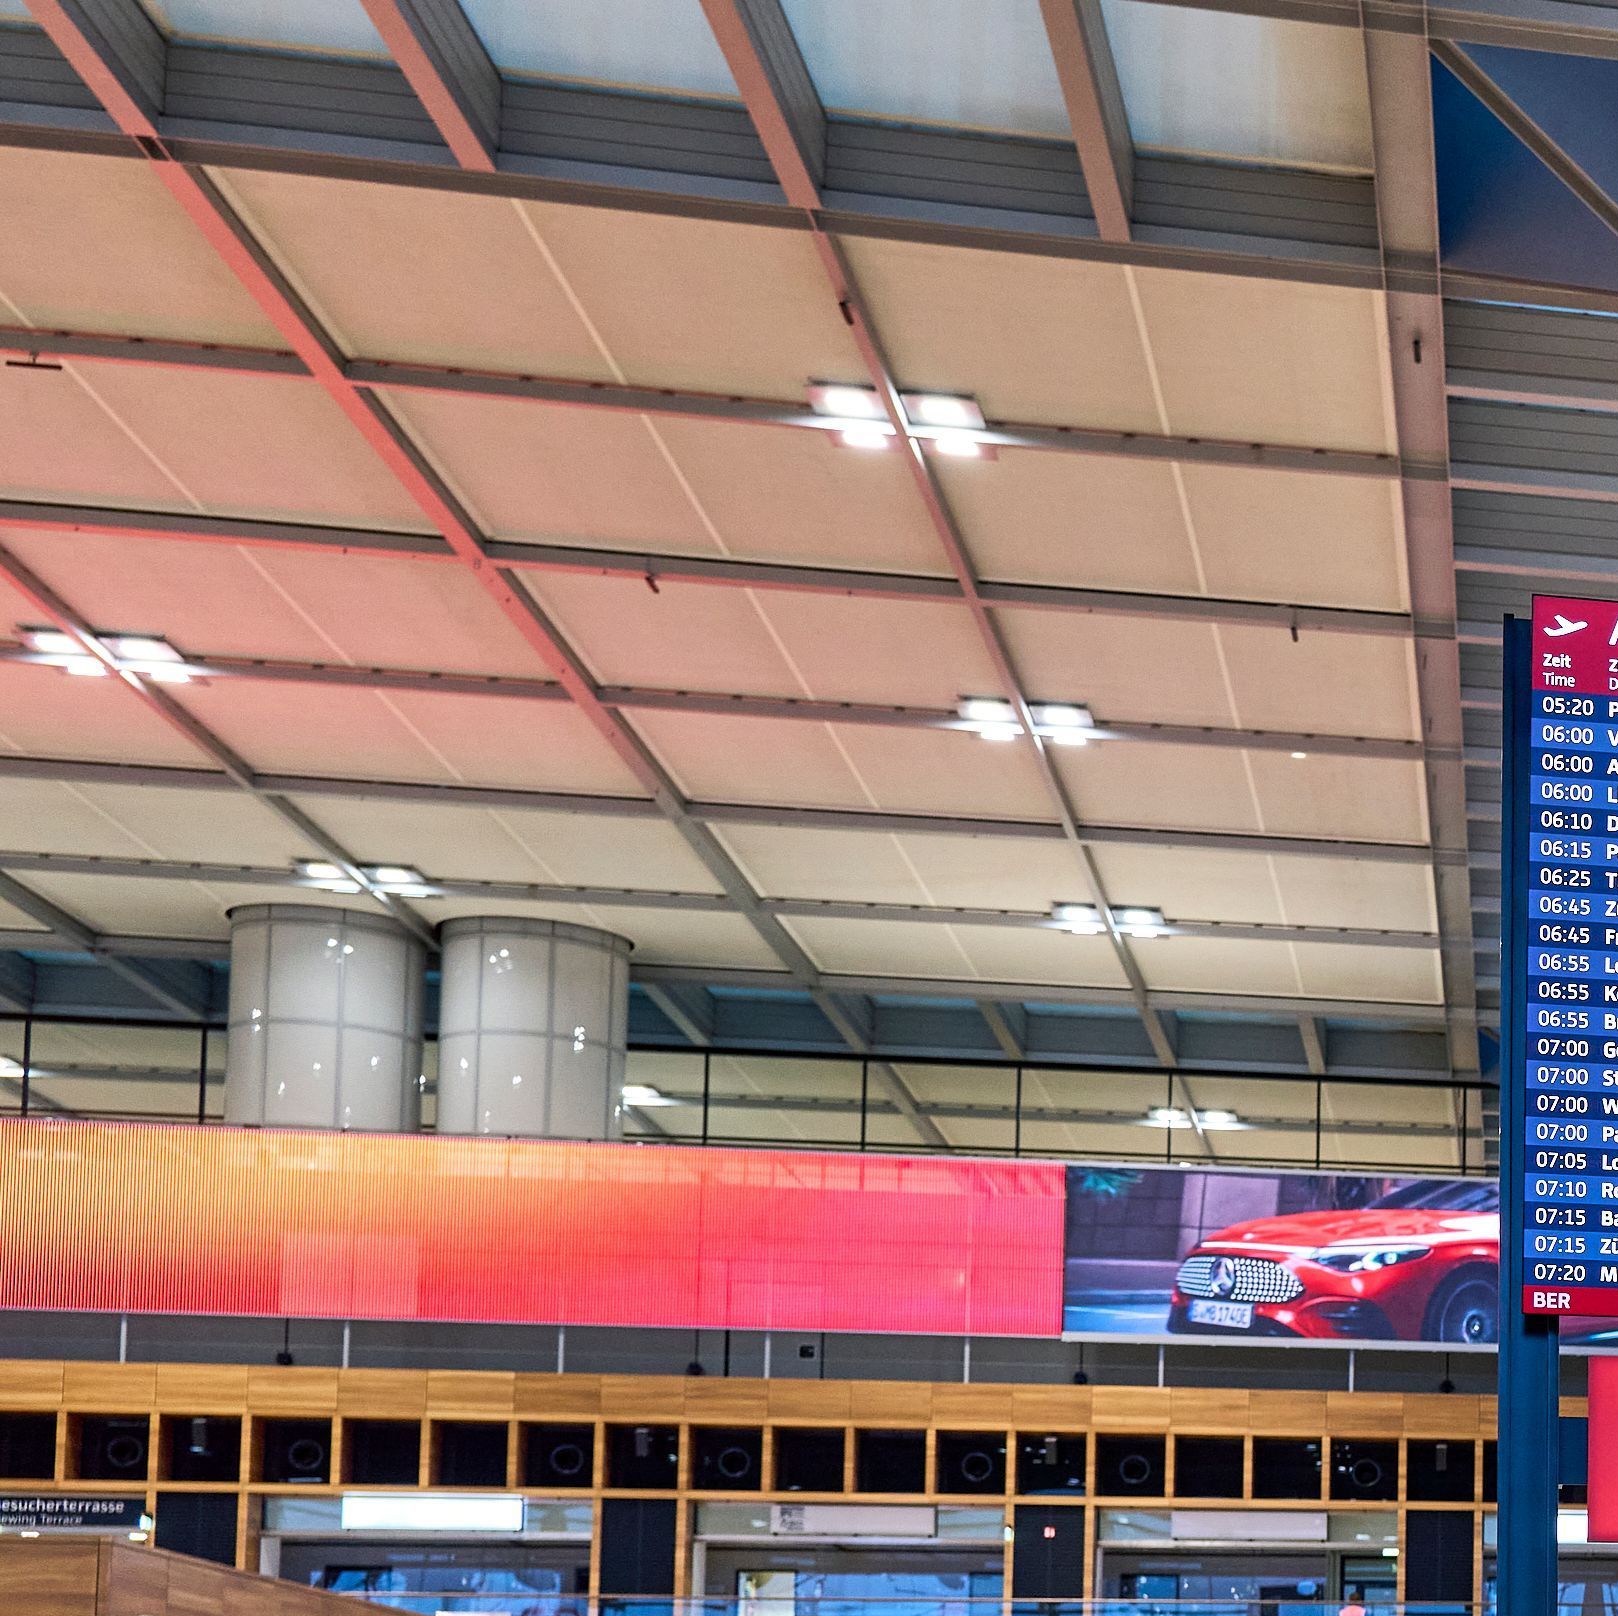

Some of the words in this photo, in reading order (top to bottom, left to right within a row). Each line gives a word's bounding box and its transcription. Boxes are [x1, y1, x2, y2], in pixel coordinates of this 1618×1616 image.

[1543, 653, 1571, 668] Zeit
[1542, 672, 1575, 687] Time
[1543, 697, 1594, 716] 05:20
[1542, 754, 1593, 773] 06:00
[1534, 1292, 1570, 1309] BER
[0, 1498, 125, 1514] esucherterrasse
[0, 1514, 36, 1527] ewing
